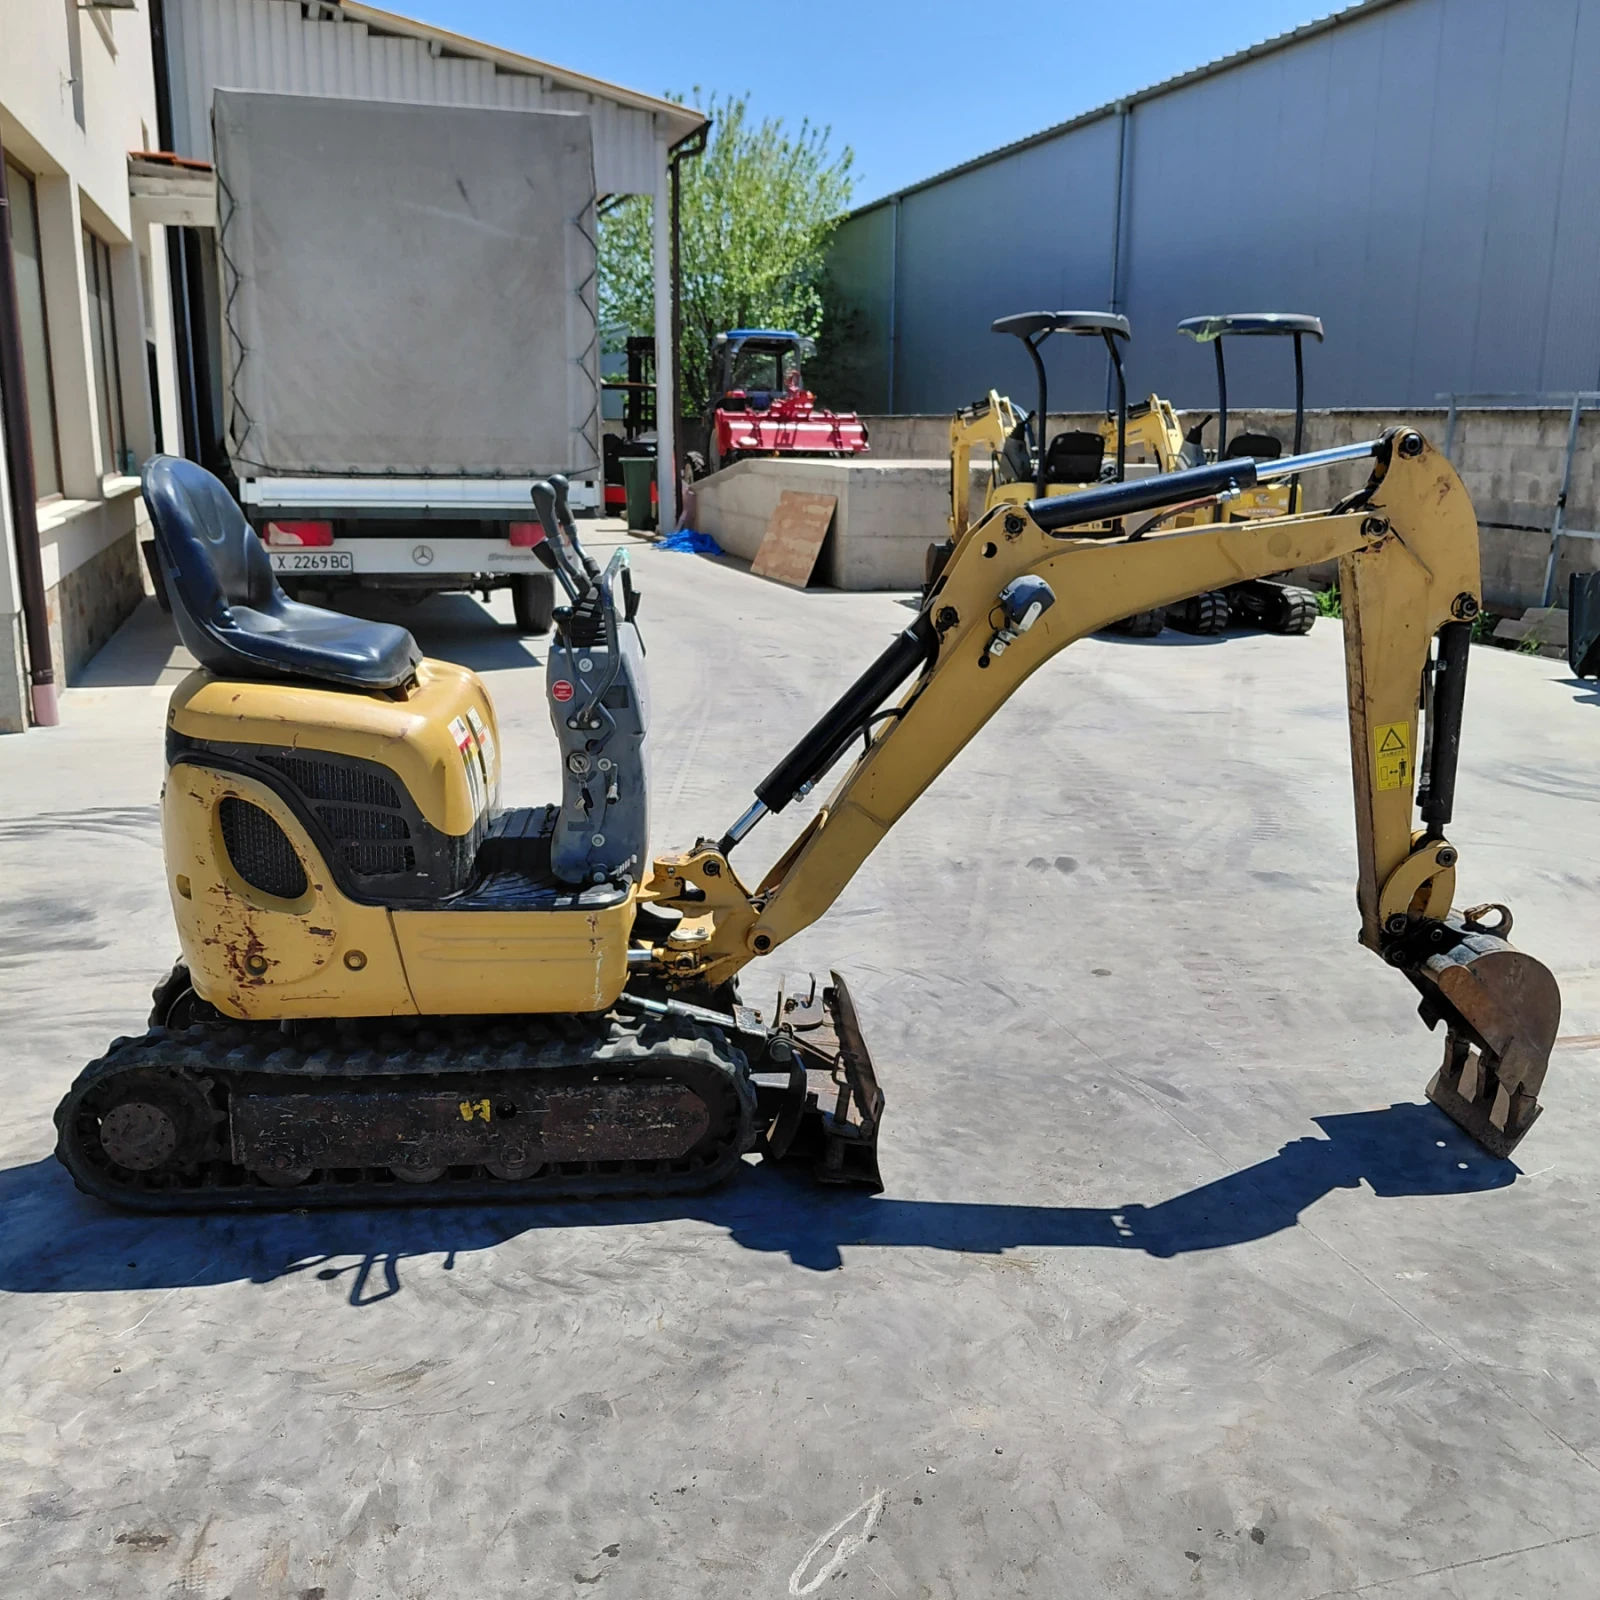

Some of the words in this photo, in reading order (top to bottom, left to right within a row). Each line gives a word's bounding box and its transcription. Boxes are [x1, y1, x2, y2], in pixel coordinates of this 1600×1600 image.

[277, 555, 287, 569] X
[293, 555, 328, 569] 2269
[331, 555, 349, 569] BC
